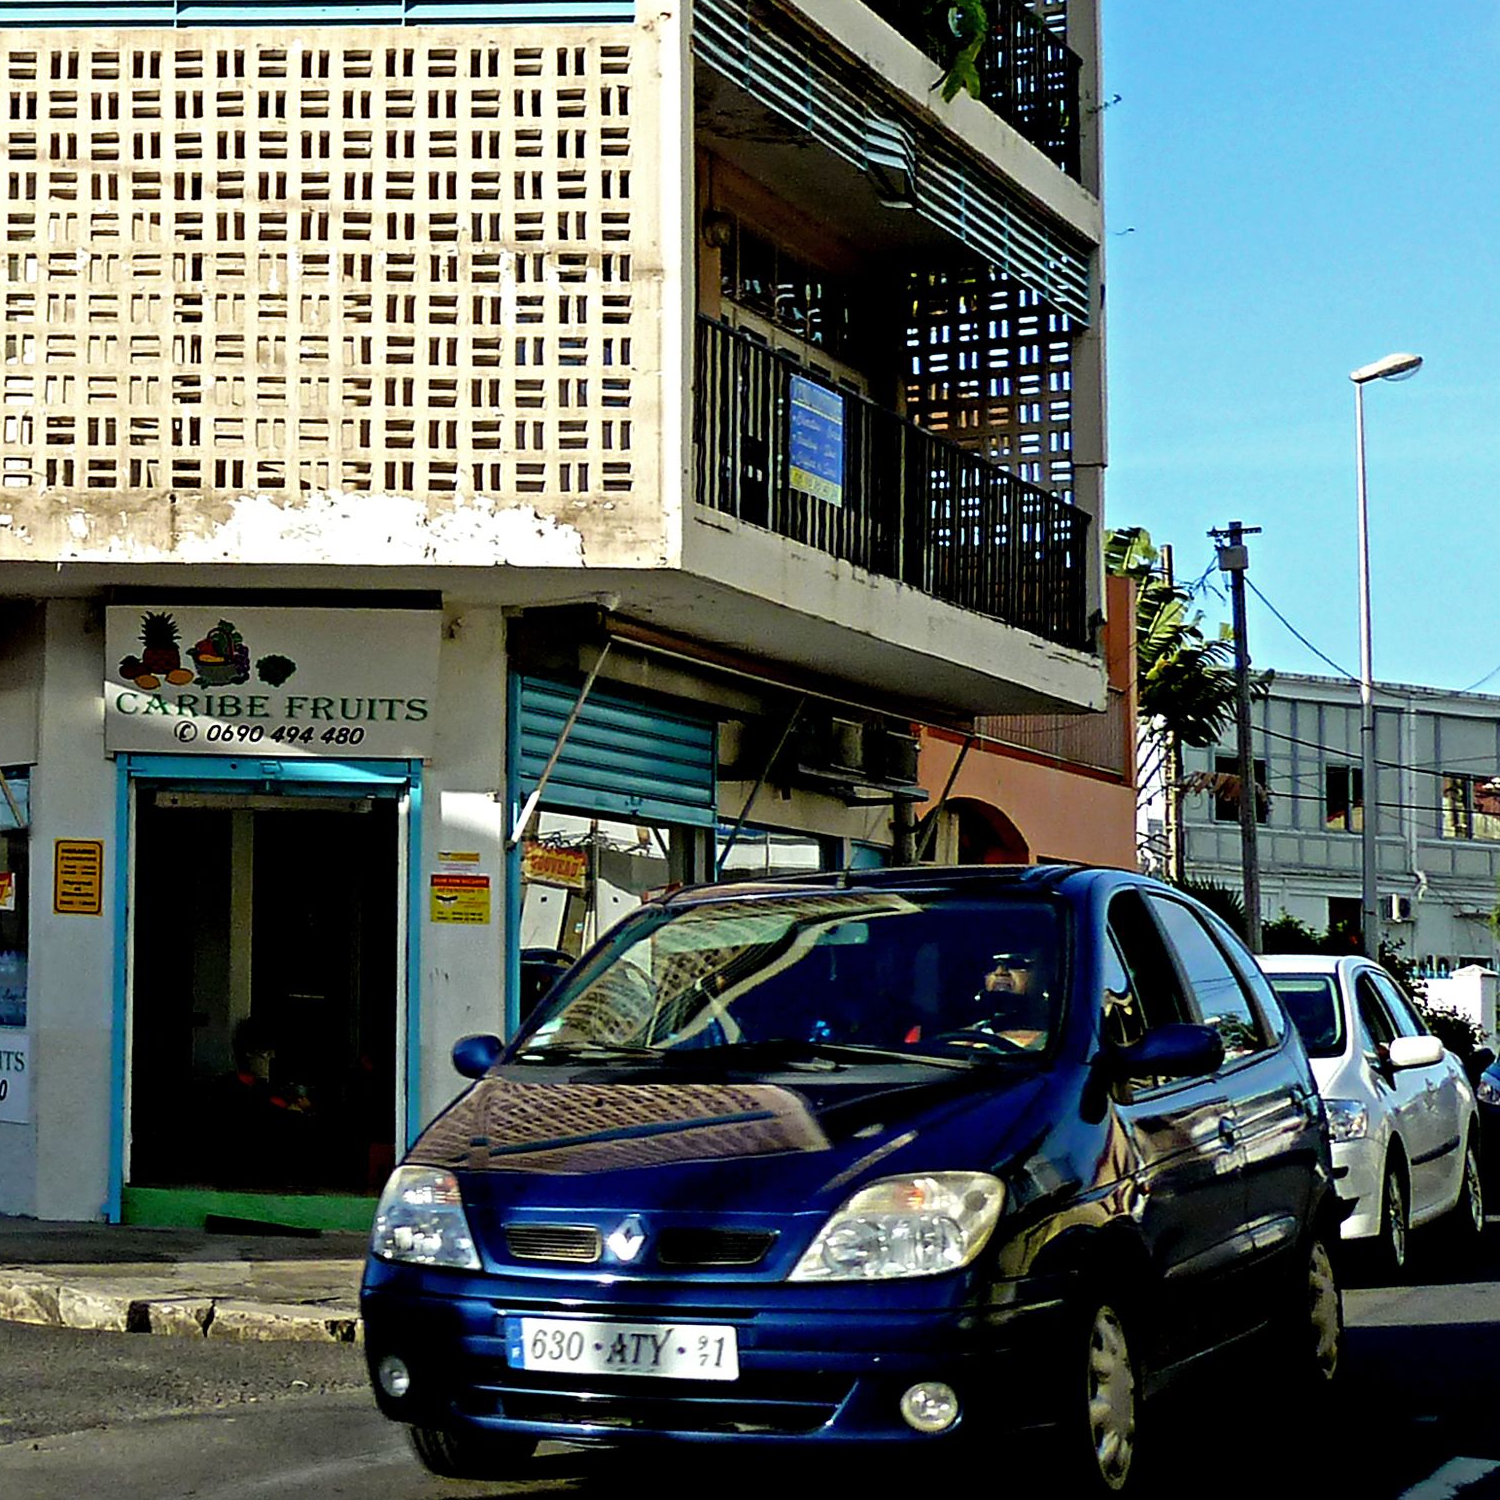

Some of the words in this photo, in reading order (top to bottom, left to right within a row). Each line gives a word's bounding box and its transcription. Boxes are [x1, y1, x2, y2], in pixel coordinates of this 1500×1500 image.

[115, 692, 270, 718] CARIBE
[285, 695, 429, 721] FRUITS
[206, 724, 264, 743] 0690
[270, 725, 315, 744] 494
[320, 726, 365, 745] 480
[531, 1329, 585, 1362] 630
[605, 1327, 675, 1367] ATY
